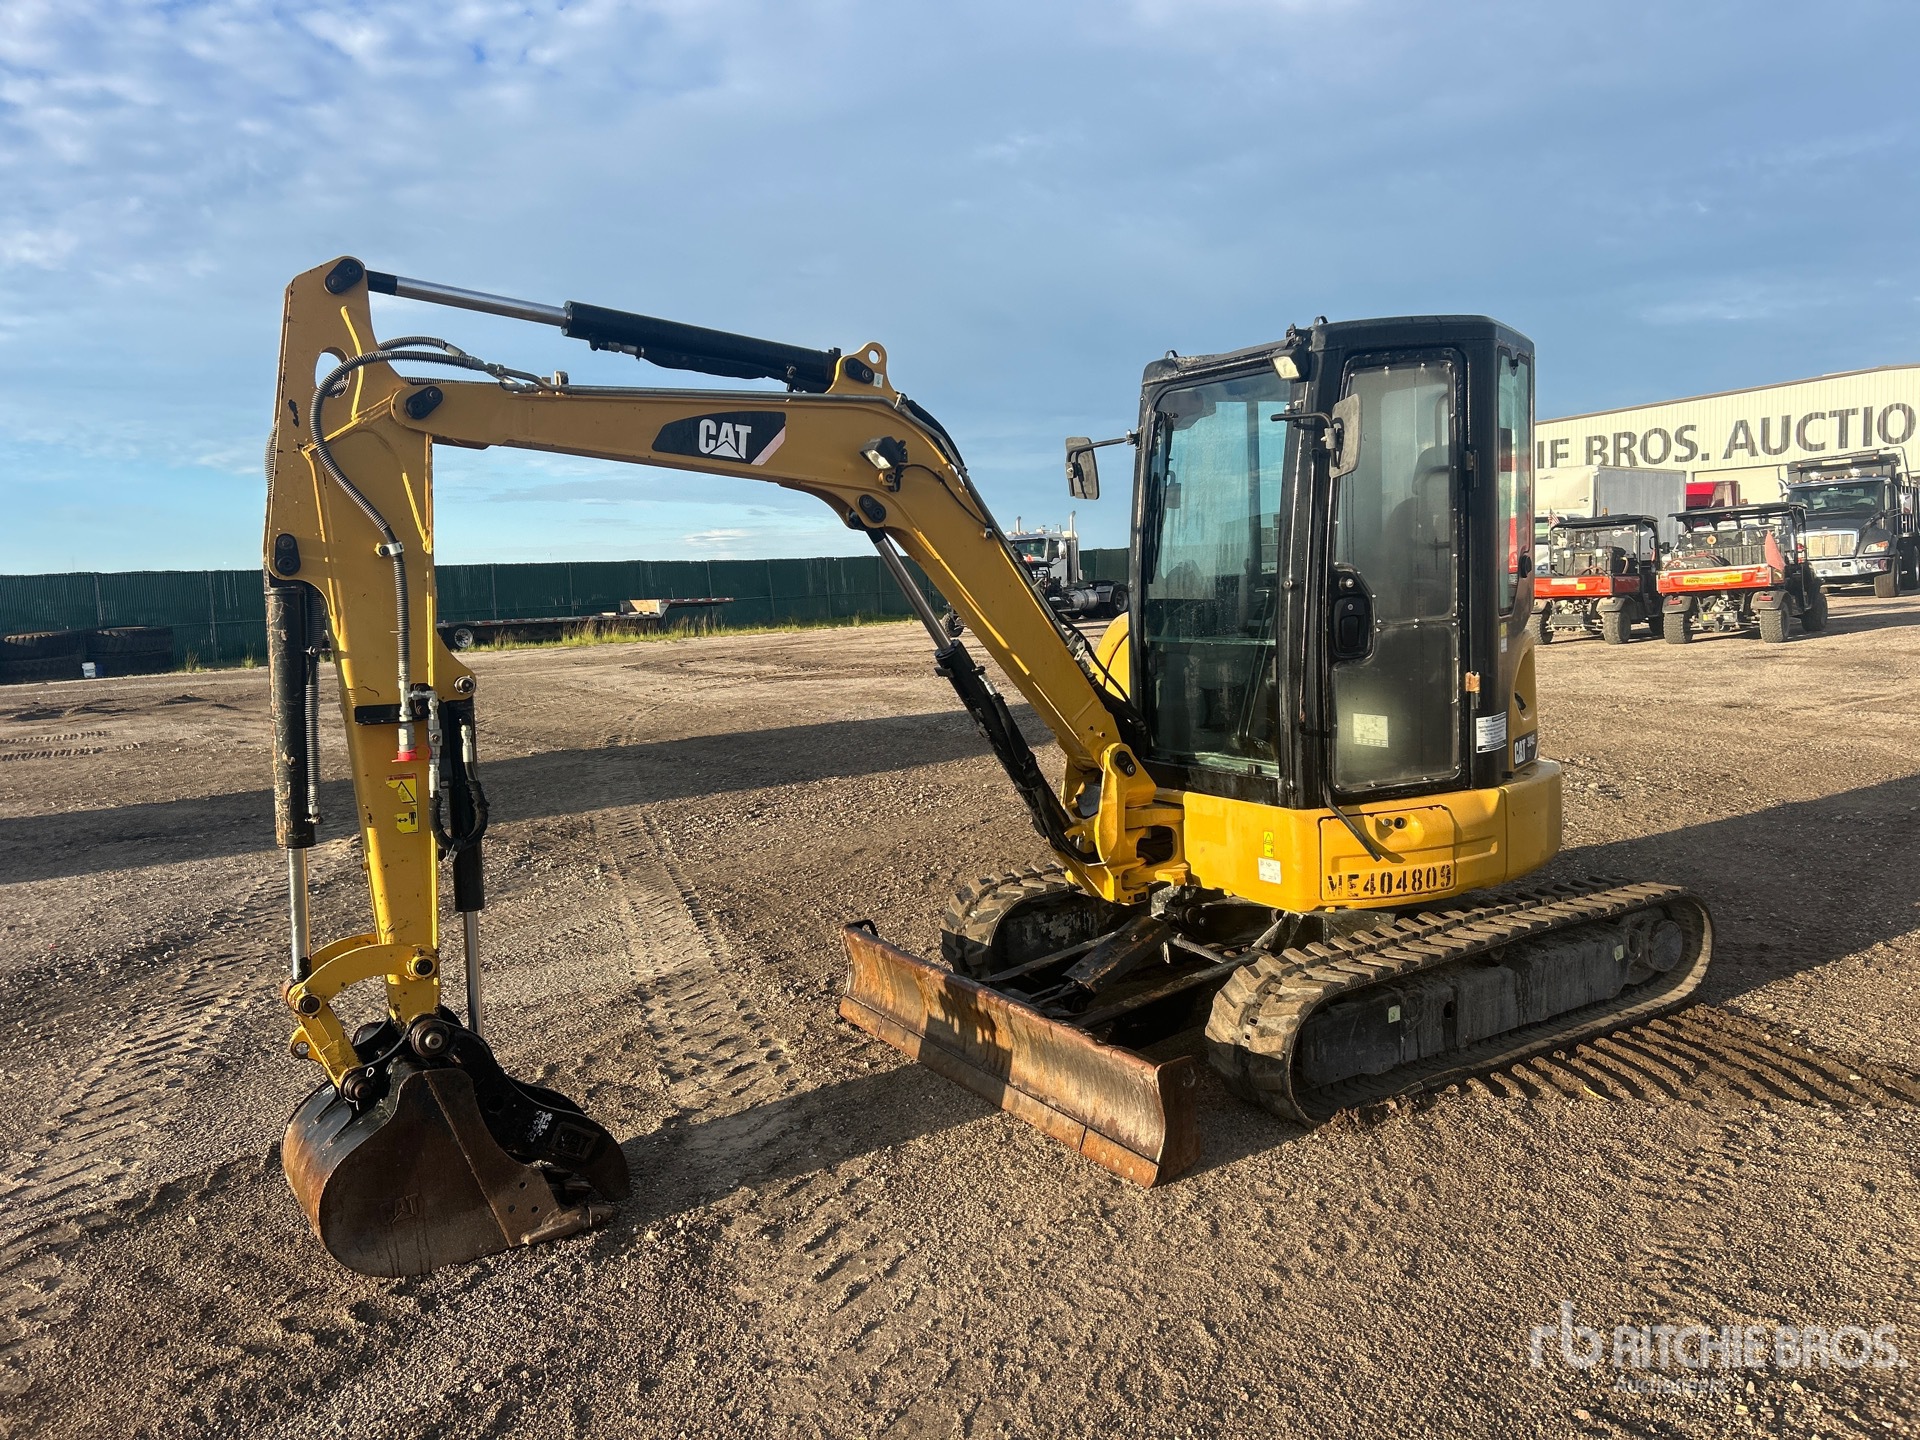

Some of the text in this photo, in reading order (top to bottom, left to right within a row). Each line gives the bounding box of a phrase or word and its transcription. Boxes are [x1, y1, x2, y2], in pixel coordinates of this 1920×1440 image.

[698, 418, 752, 459] CAT
[1585, 424, 1710, 467] BROS.
[1722, 402, 1917, 460] AUCTIO
[1514, 738, 1526, 765] CAT
